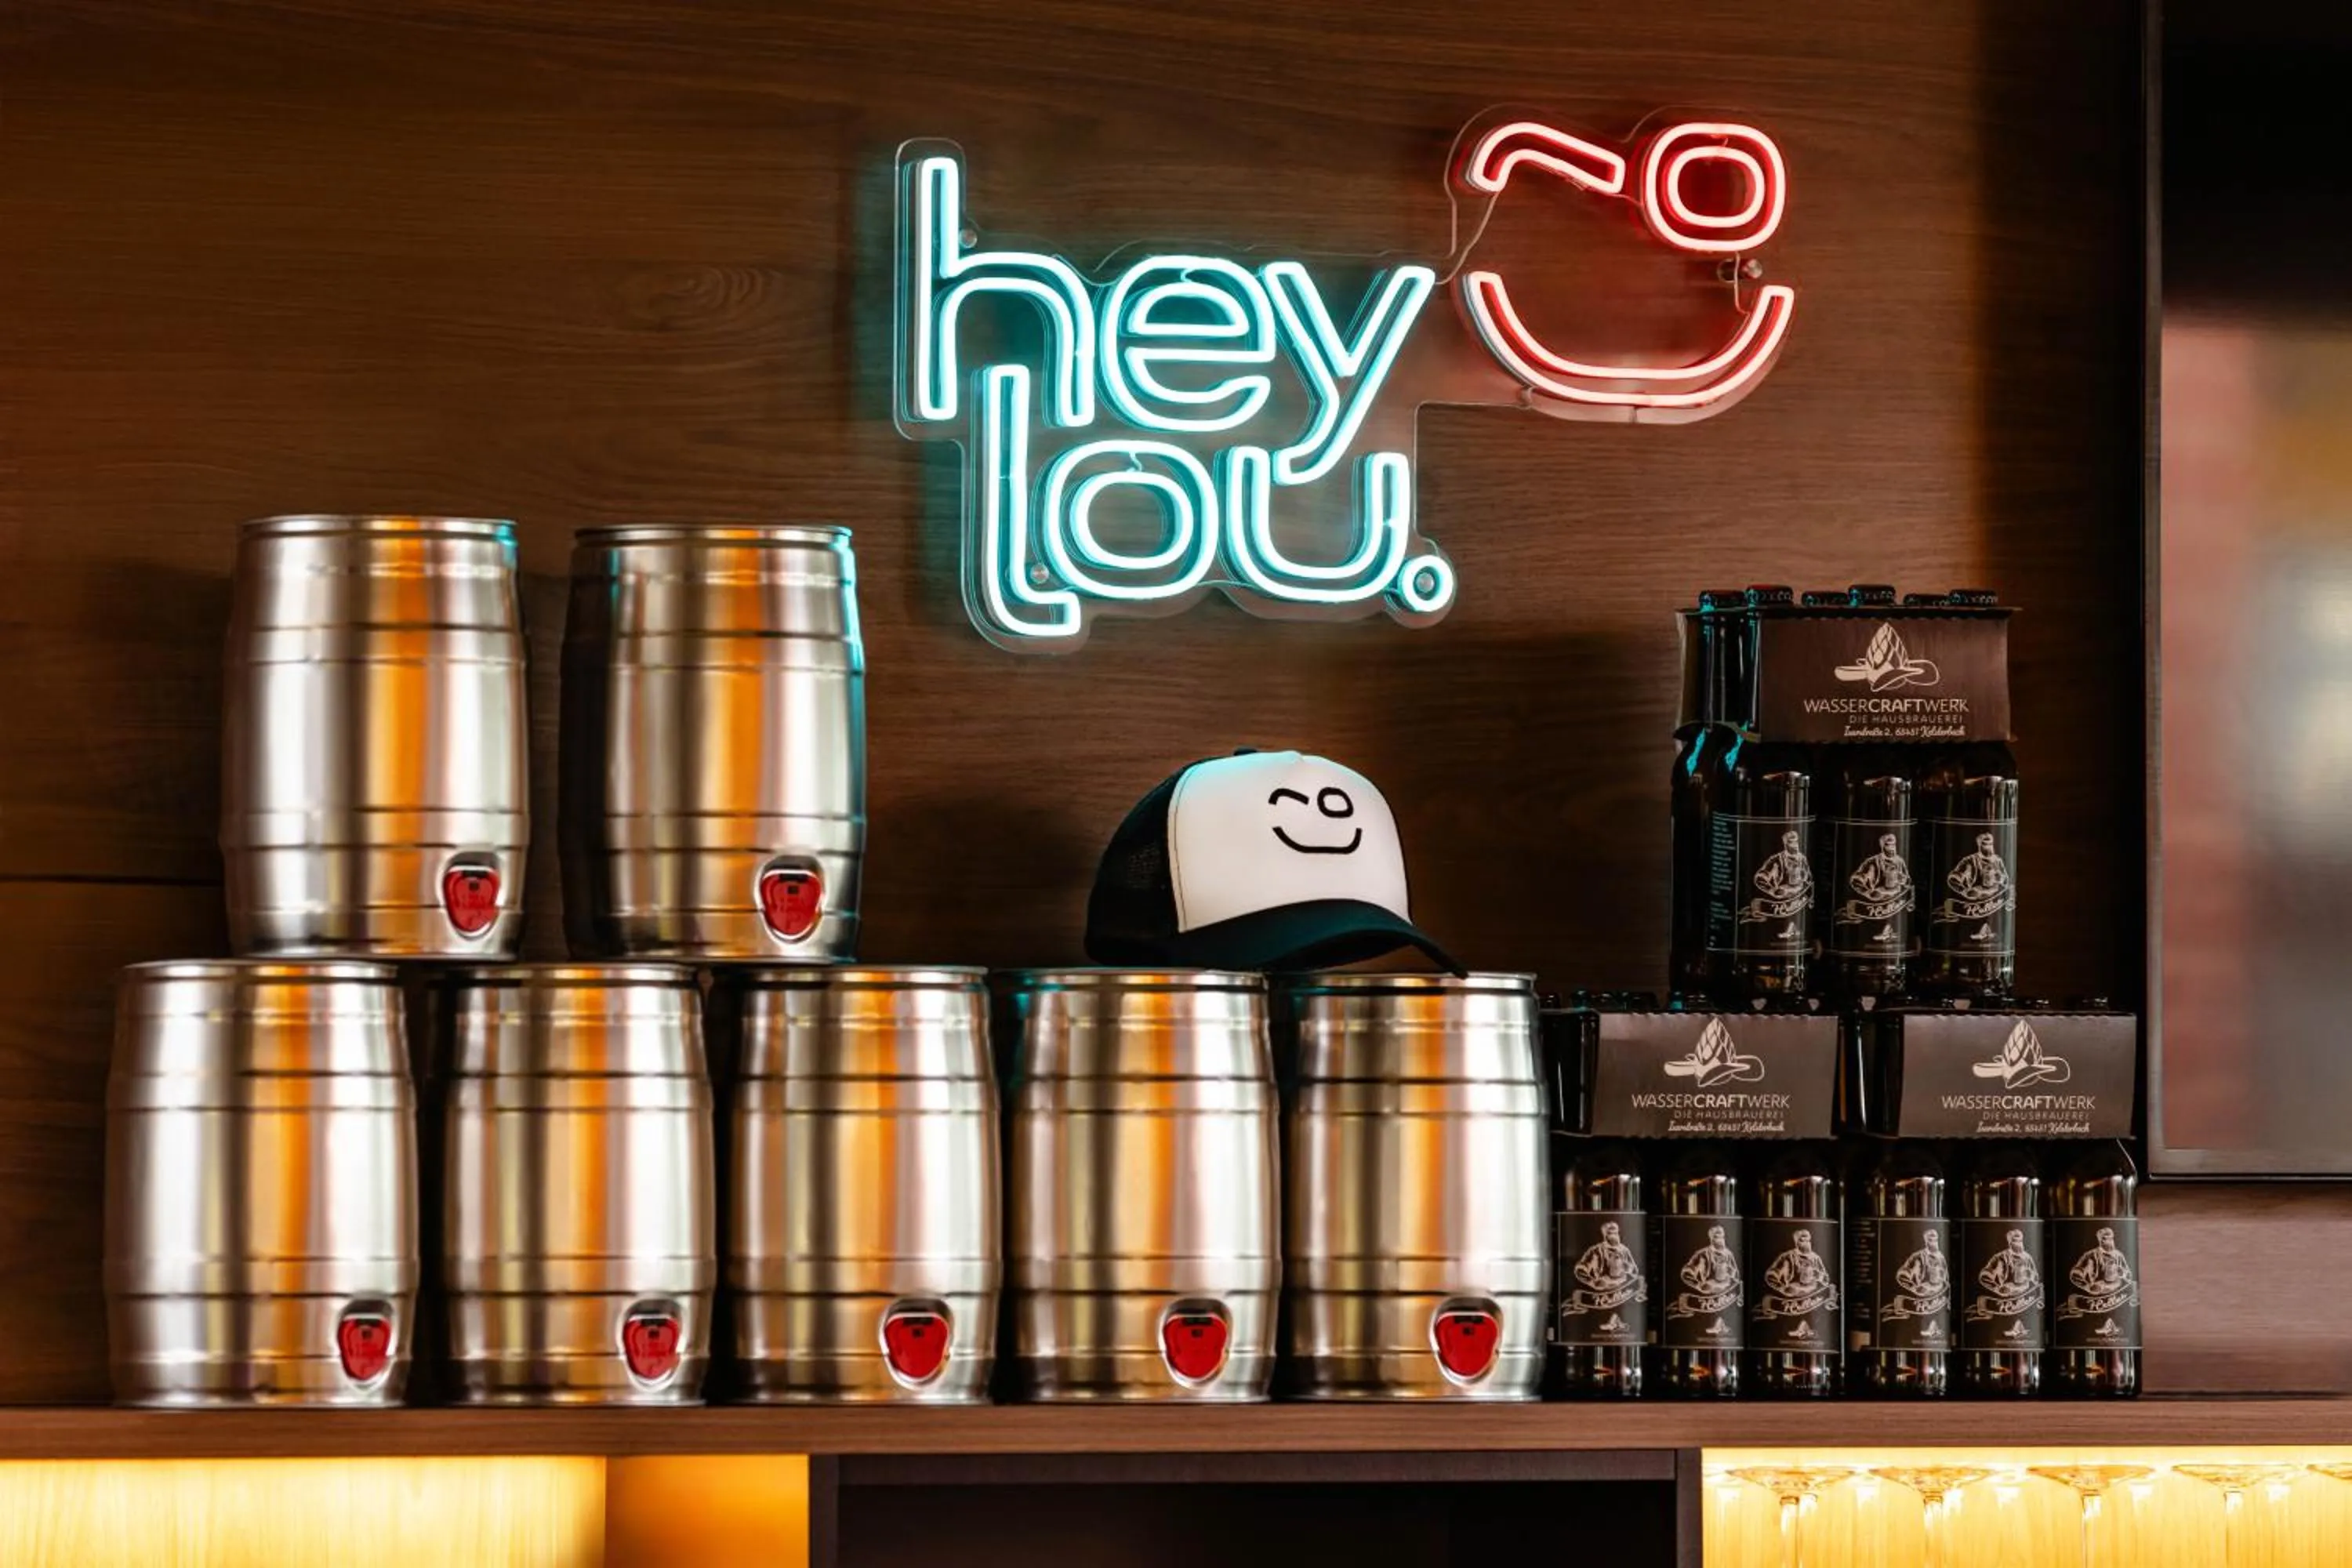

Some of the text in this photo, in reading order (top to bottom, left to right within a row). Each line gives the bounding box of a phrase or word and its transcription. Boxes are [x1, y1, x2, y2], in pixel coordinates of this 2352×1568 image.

[916, 157, 1436, 485] hey
[1804, 699, 1969, 713] WASSERCRAFTWERK
[1849, 714, 1962, 724] DIE HAUSBRAUEREI
[1632, 1094, 1791, 1109] WASSERCRAFTWERK
[1942, 1095, 2096, 1109] WASSERCRAFTWERK
[1674, 1110, 1784, 1119] DIE HAUSBRAUEREI
[1983, 1112, 2089, 1120] DIE HAUSBRAUEREI
